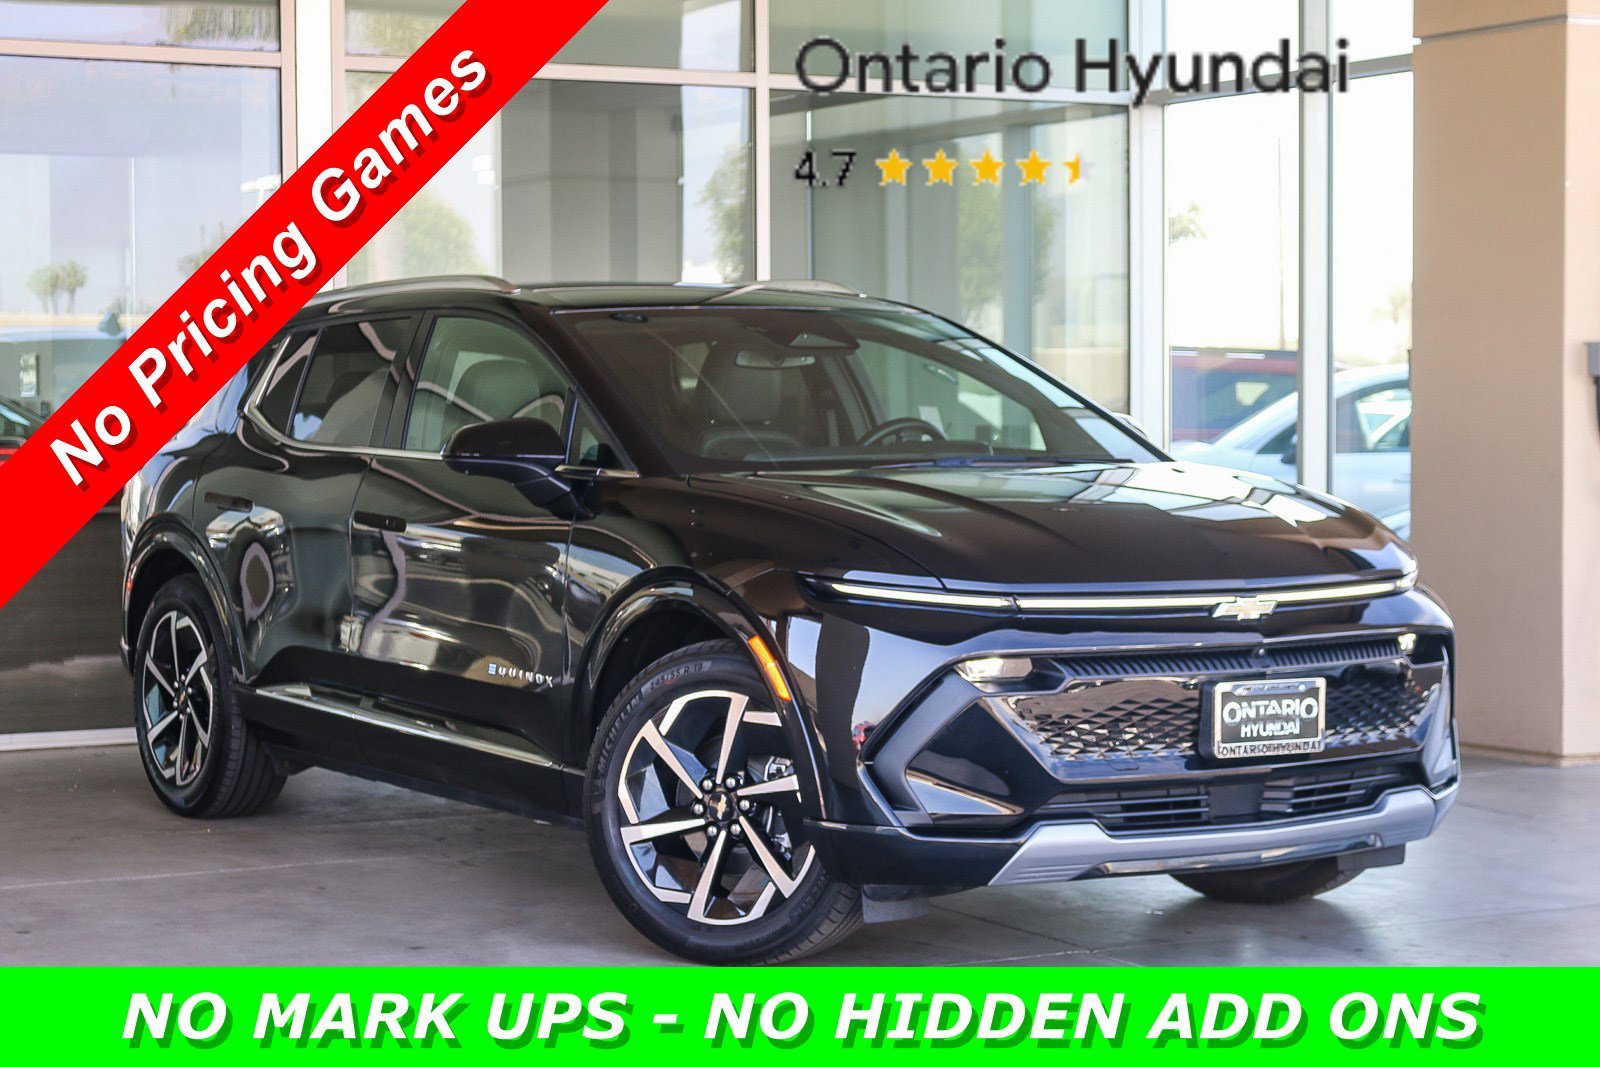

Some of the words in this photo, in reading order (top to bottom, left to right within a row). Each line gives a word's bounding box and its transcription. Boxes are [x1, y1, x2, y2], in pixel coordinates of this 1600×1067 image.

[1222, 696, 1319, 725] ONTARIO
[597, 692, 643, 776] MICHELIN
[1240, 718, 1301, 739] HYUNDAI
